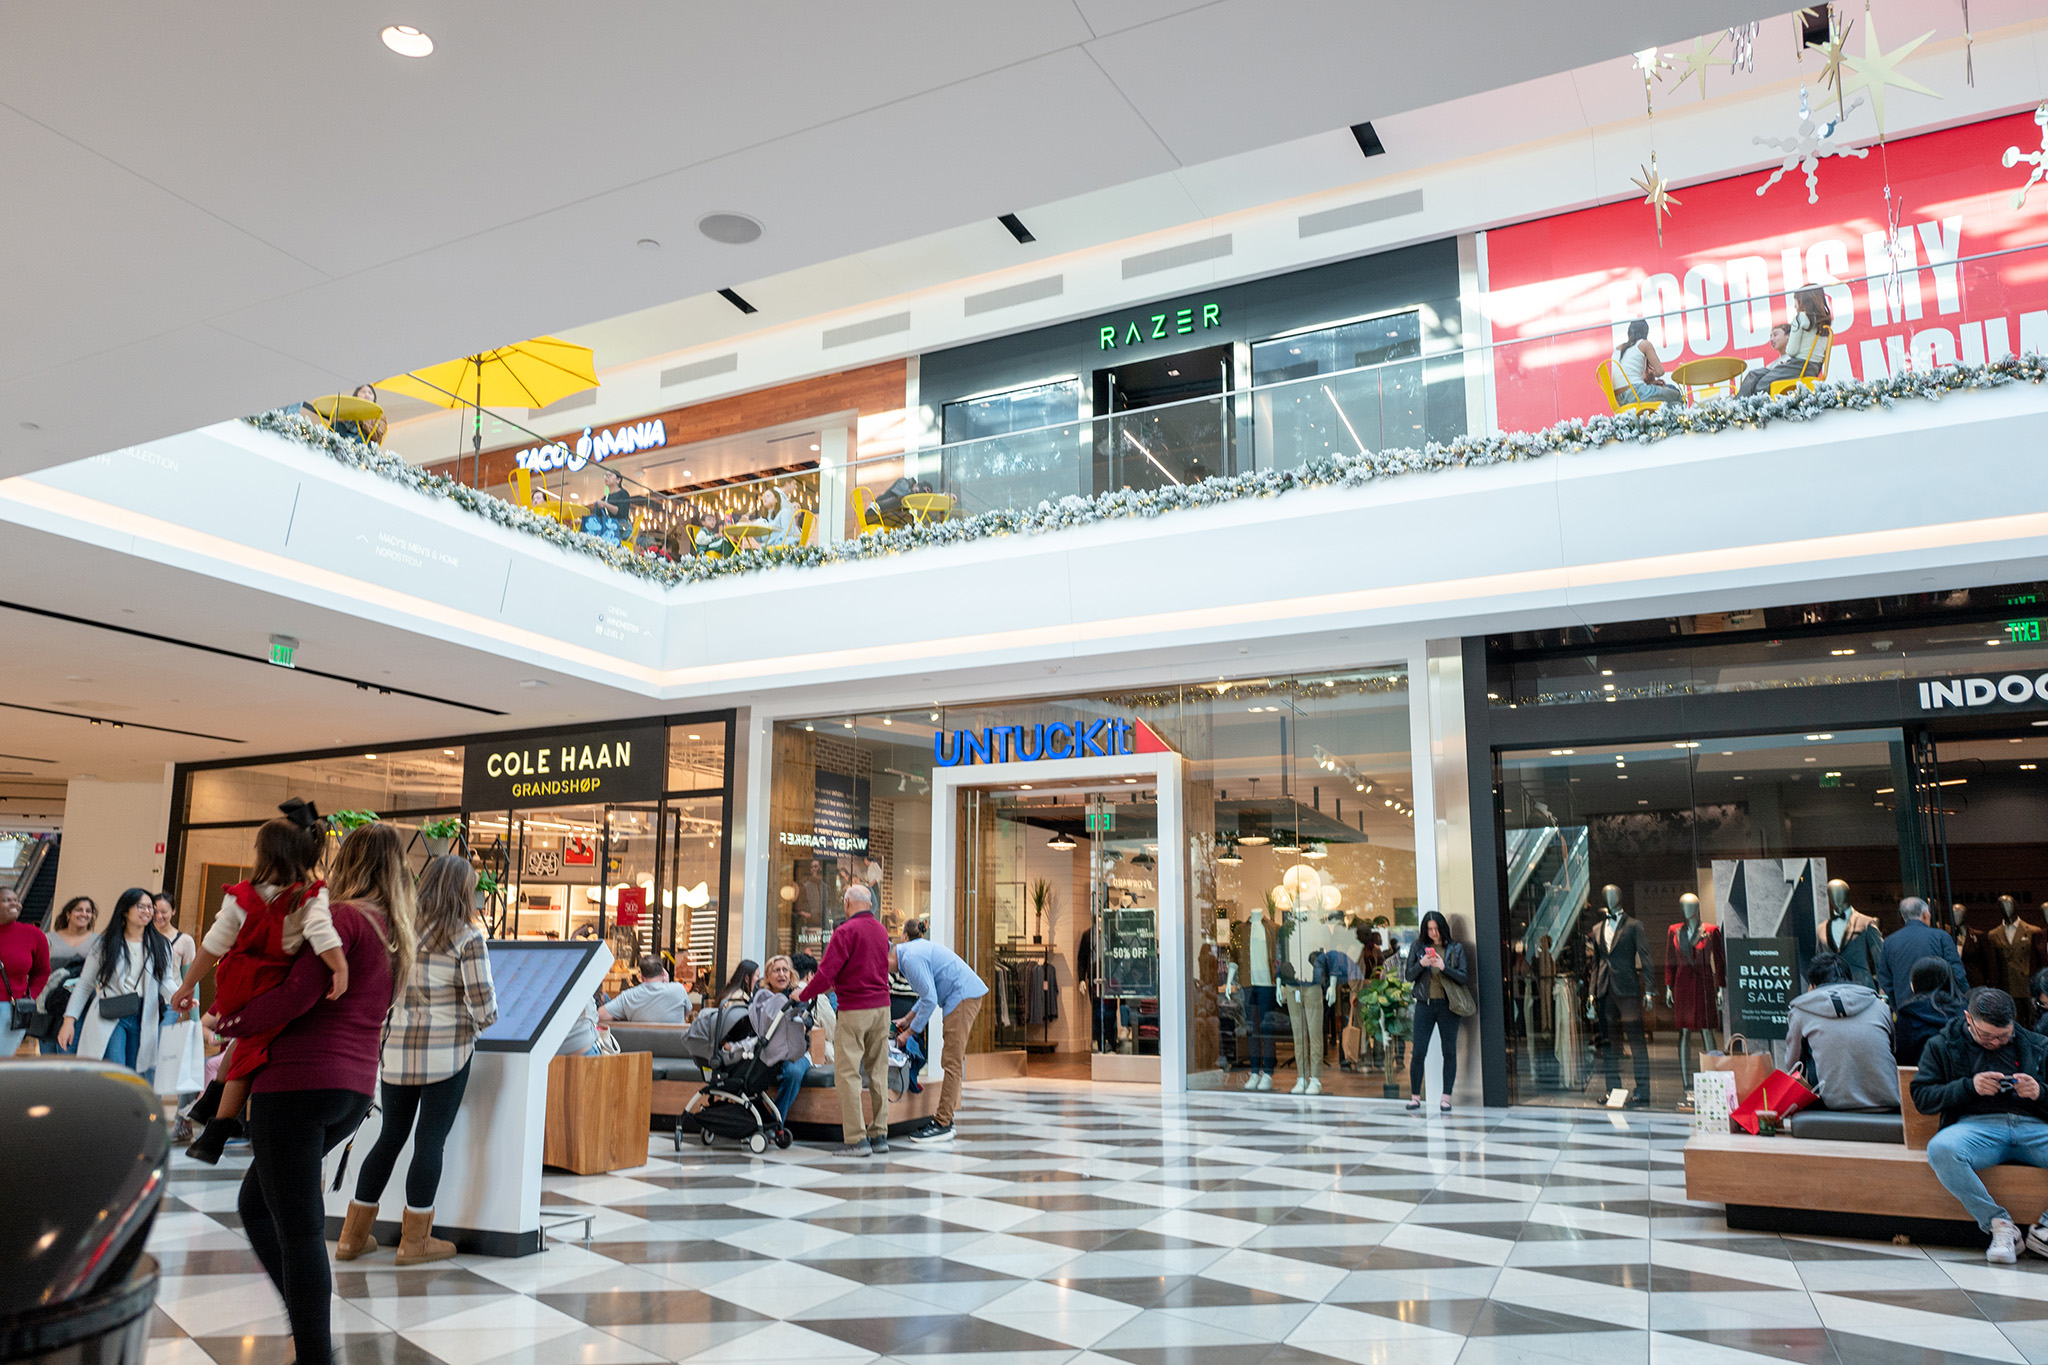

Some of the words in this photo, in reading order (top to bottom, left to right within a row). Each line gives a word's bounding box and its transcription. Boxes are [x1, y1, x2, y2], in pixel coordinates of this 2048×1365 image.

[1781, 239, 1855, 336] IS
[1862, 215, 1963, 328] MY
[1100, 303, 1221, 350] RAZER
[515, 441, 568, 473] TACO
[593, 419, 667, 463] MANIA
[376, 545, 423, 568] NORDSTROM
[439, 552, 459, 568] HOME
[273, 644, 293, 665] EXIT
[487, 749, 550, 778] COLE
[561, 741, 631, 772] HAAN
[512, 777, 601, 798] GRANDSHØP
[1113, 946, 1131, 959] 50%
[1132, 946, 1148, 959] OFF
[1740, 965, 1790, 977] BLACK
[1739, 979, 1792, 990] FRIDAY
[1748, 992, 1785, 1004] SALE
